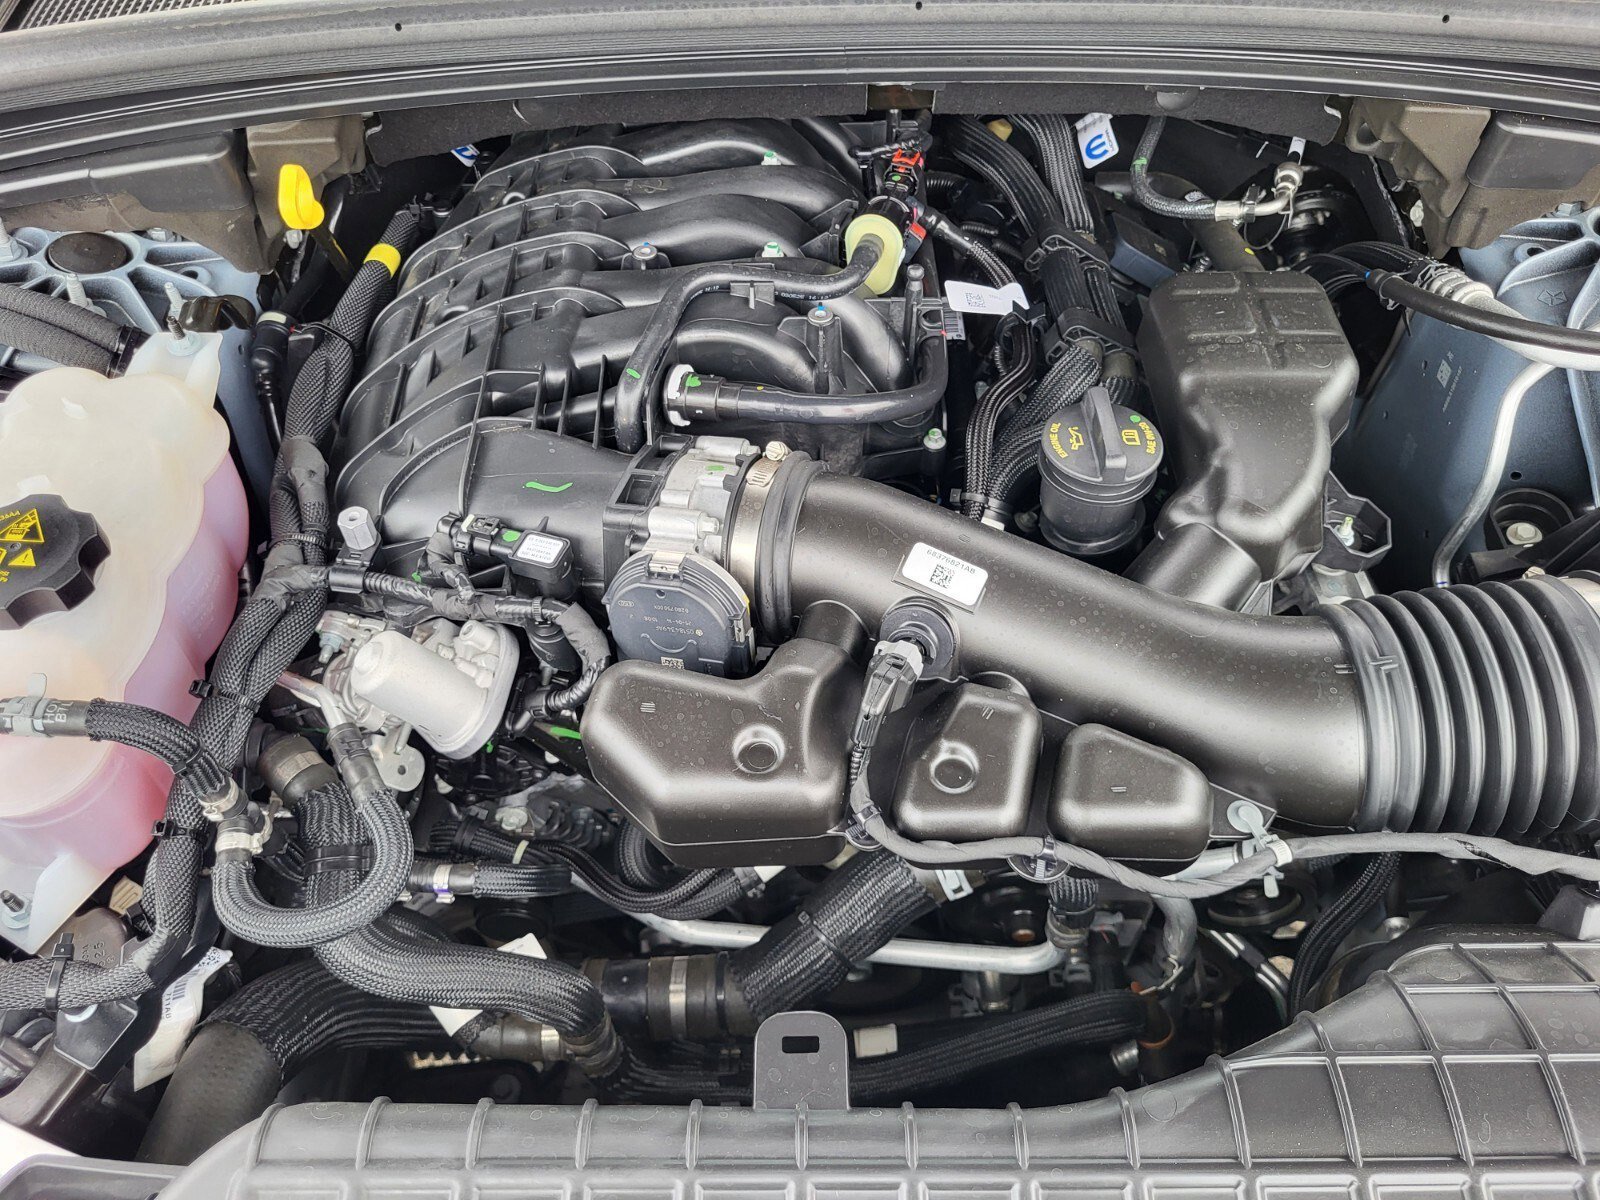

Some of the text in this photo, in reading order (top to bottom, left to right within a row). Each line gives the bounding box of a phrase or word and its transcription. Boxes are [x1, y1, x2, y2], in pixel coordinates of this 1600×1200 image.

[1049, 422, 1069, 459] ENGINE OIL
[1146, 440, 1157, 455] SAE
